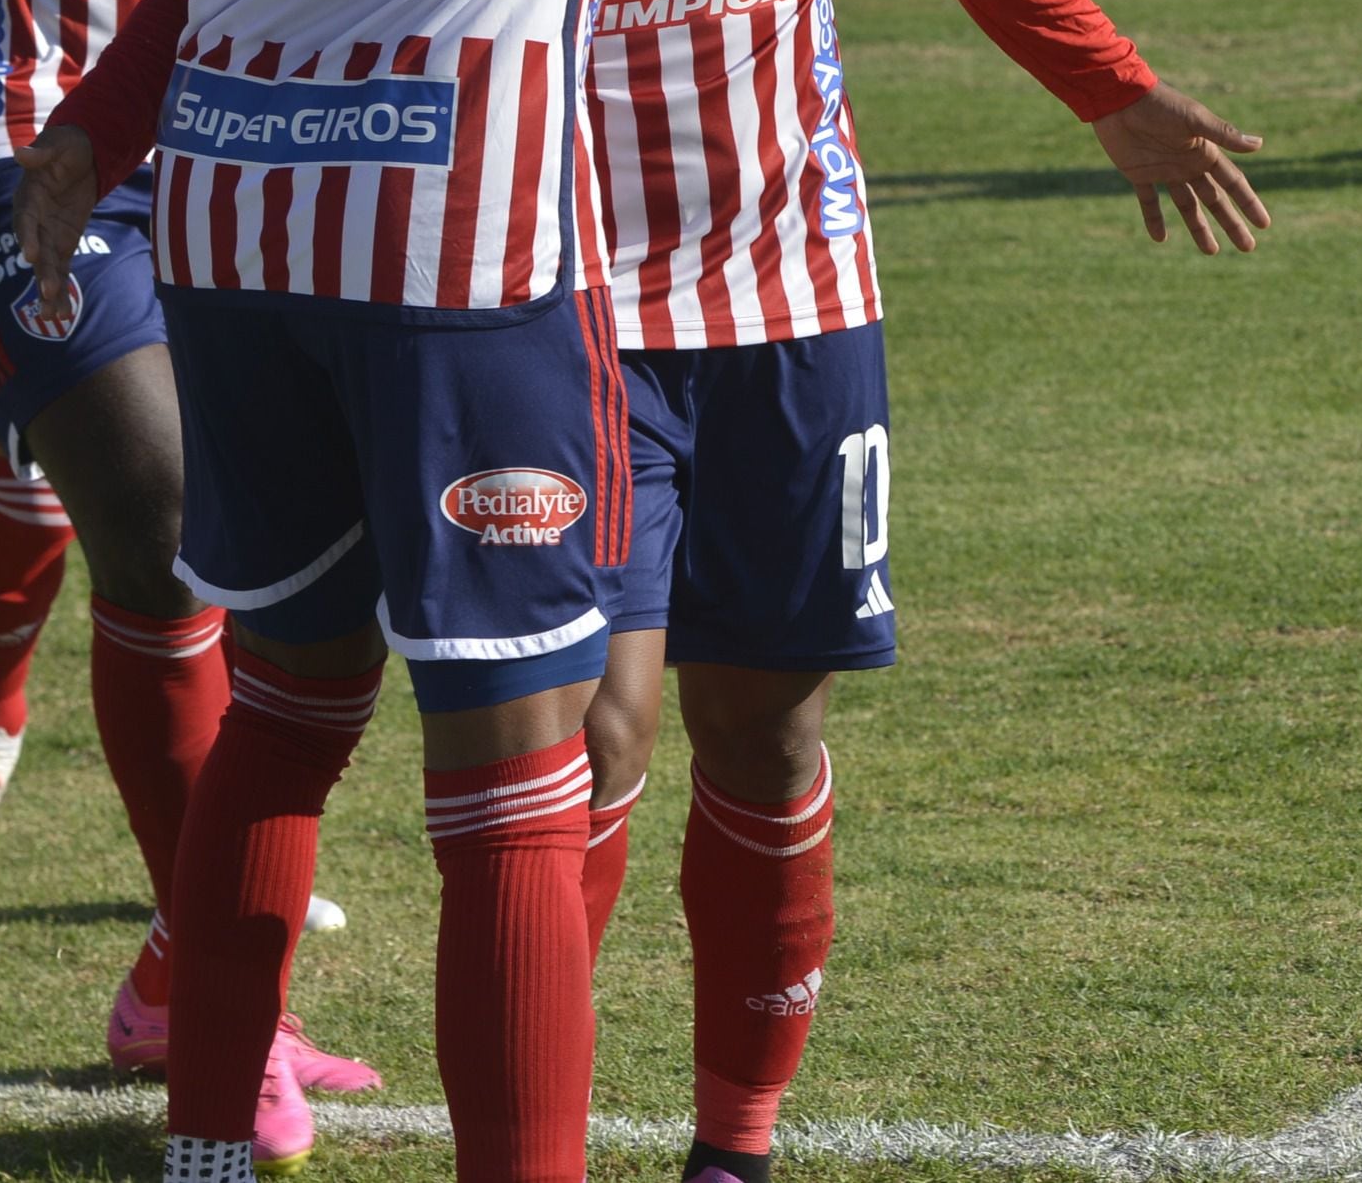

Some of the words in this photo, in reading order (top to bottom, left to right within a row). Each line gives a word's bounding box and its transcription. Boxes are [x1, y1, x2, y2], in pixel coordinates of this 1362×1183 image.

[456, 485, 581, 523] Pedialyte
[838, 423, 890, 569] 10
[480, 522, 561, 546] Active
